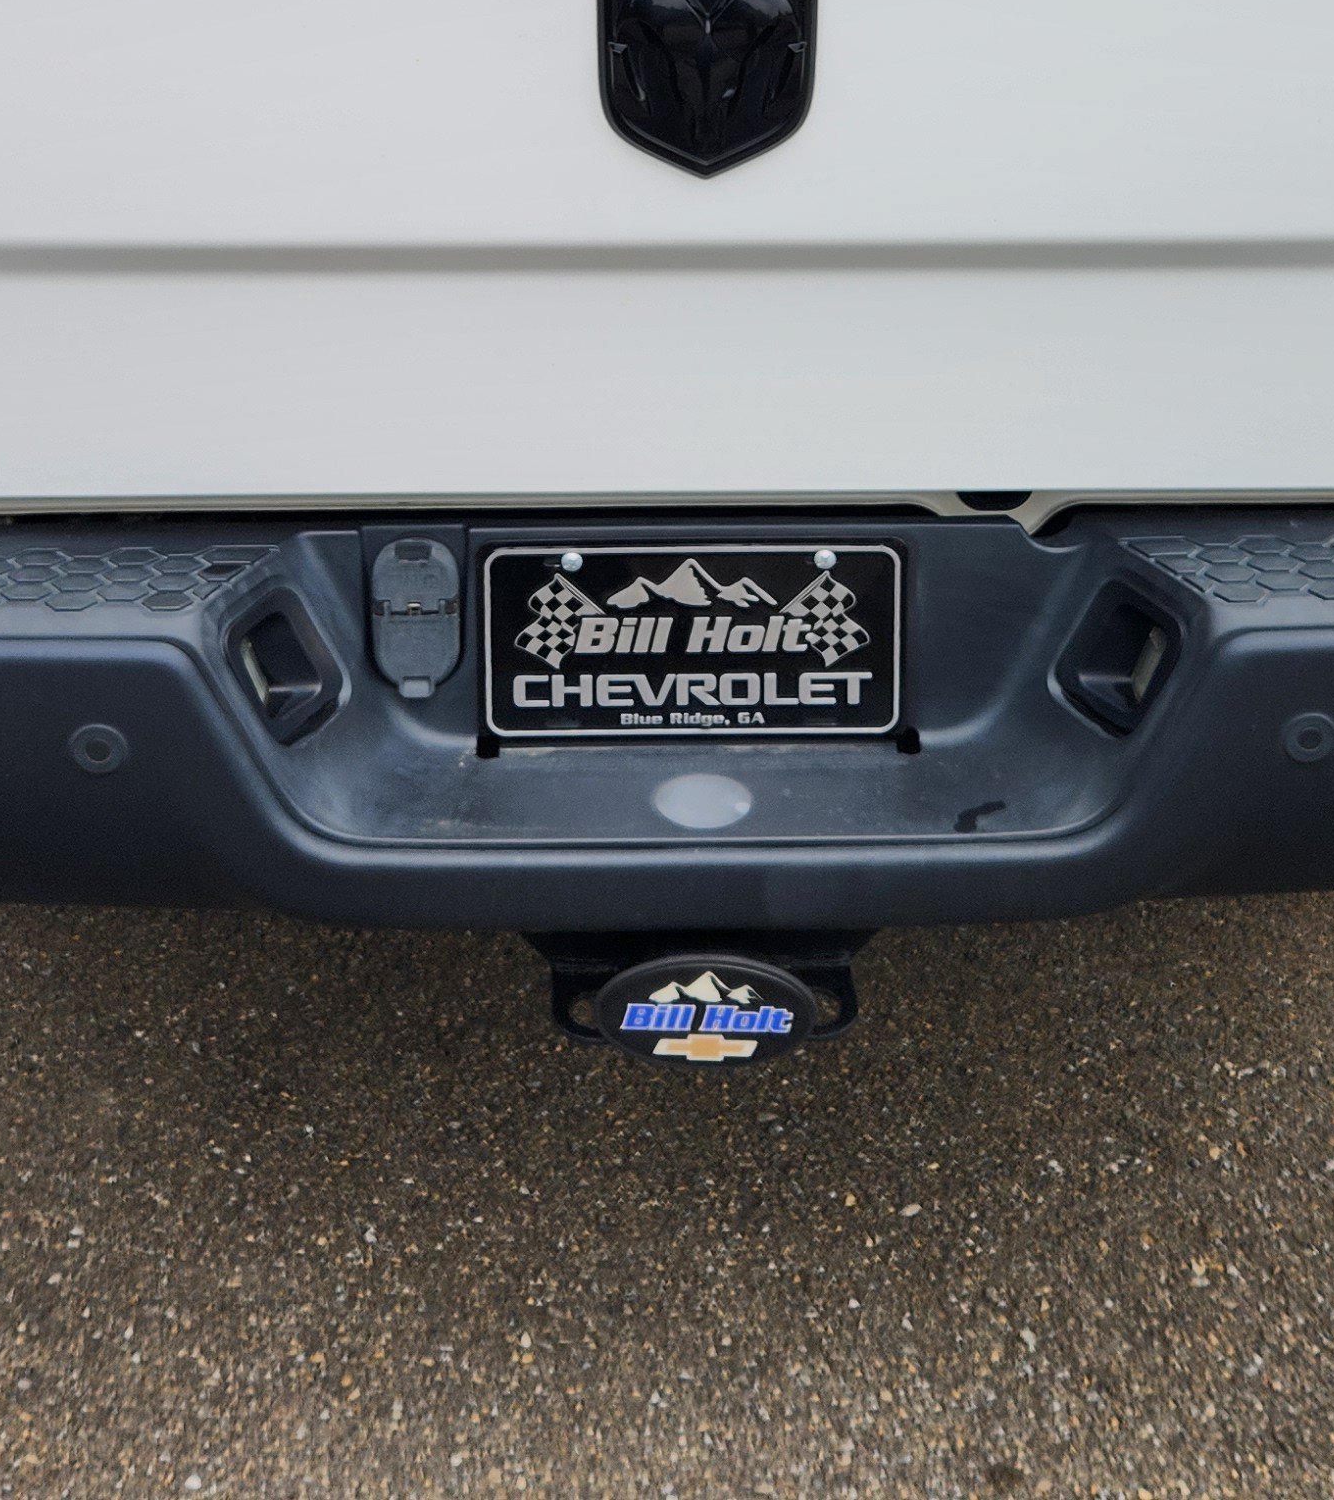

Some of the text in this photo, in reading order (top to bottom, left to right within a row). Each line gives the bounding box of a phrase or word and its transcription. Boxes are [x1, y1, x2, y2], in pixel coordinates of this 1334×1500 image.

[574, 615, 811, 653] Bill Holt
[513, 671, 873, 708] CHEVROLET
[620, 711, 765, 727] Blue Ridge, GA
[620, 1002, 794, 1033] Bill Holt
